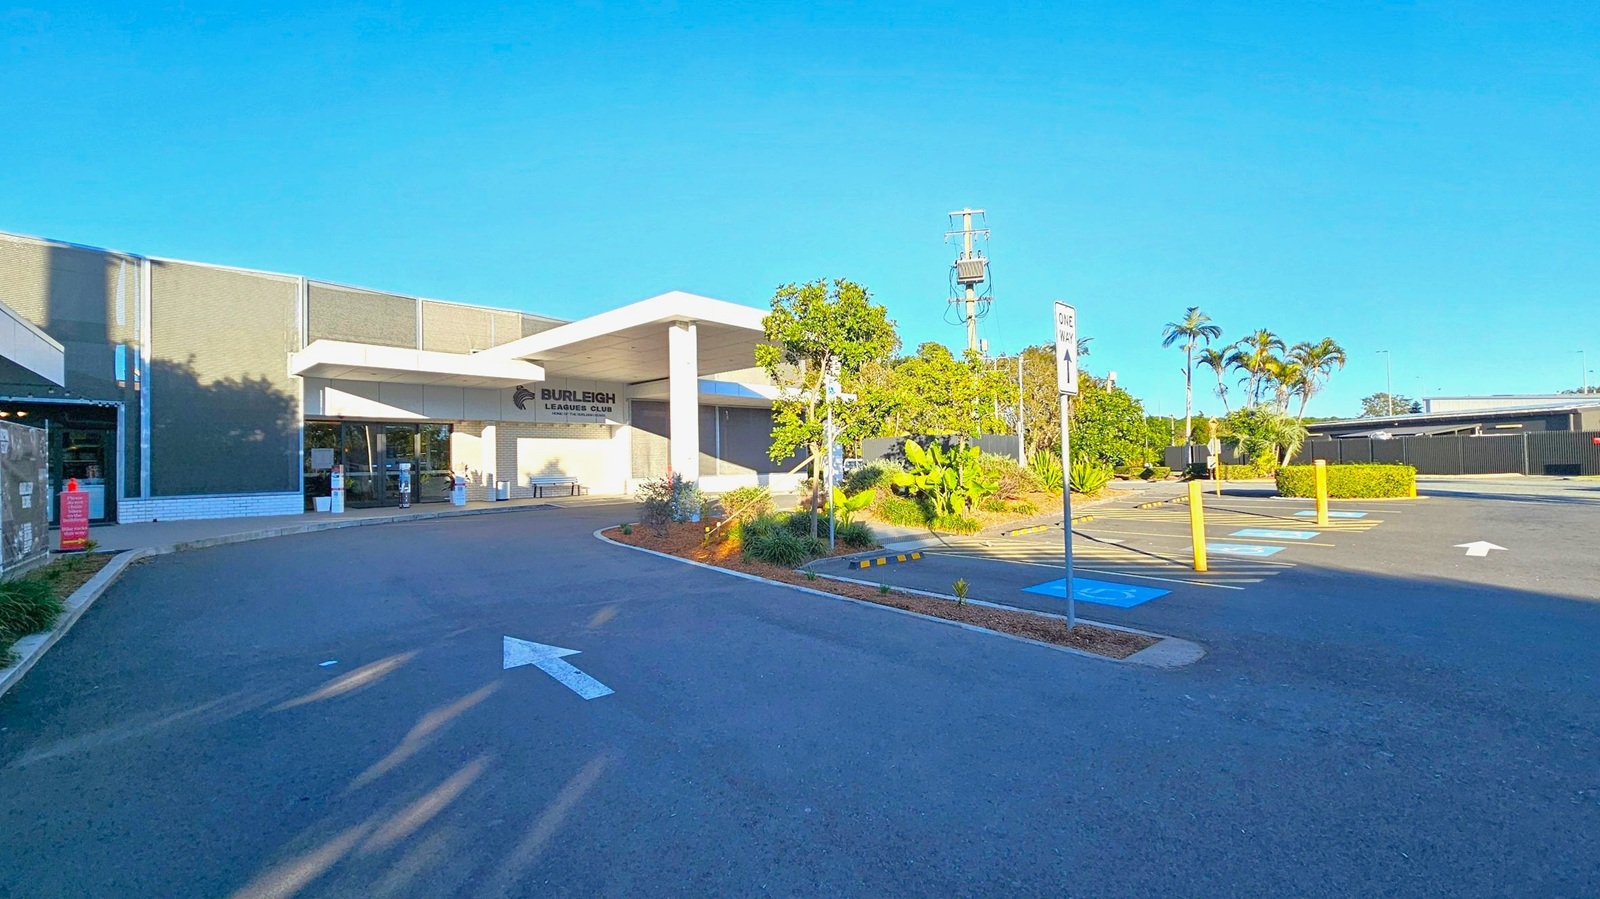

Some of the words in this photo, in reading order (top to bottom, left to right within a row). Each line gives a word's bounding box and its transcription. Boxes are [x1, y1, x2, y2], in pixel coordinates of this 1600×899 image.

[1058, 312, 1073, 328] ONE
[1059, 329, 1073, 344] WAY
[541, 388, 615, 404] BURLEIGH
[545, 403, 587, 411] LEAGUES
[590, 405, 612, 413] CLUB
